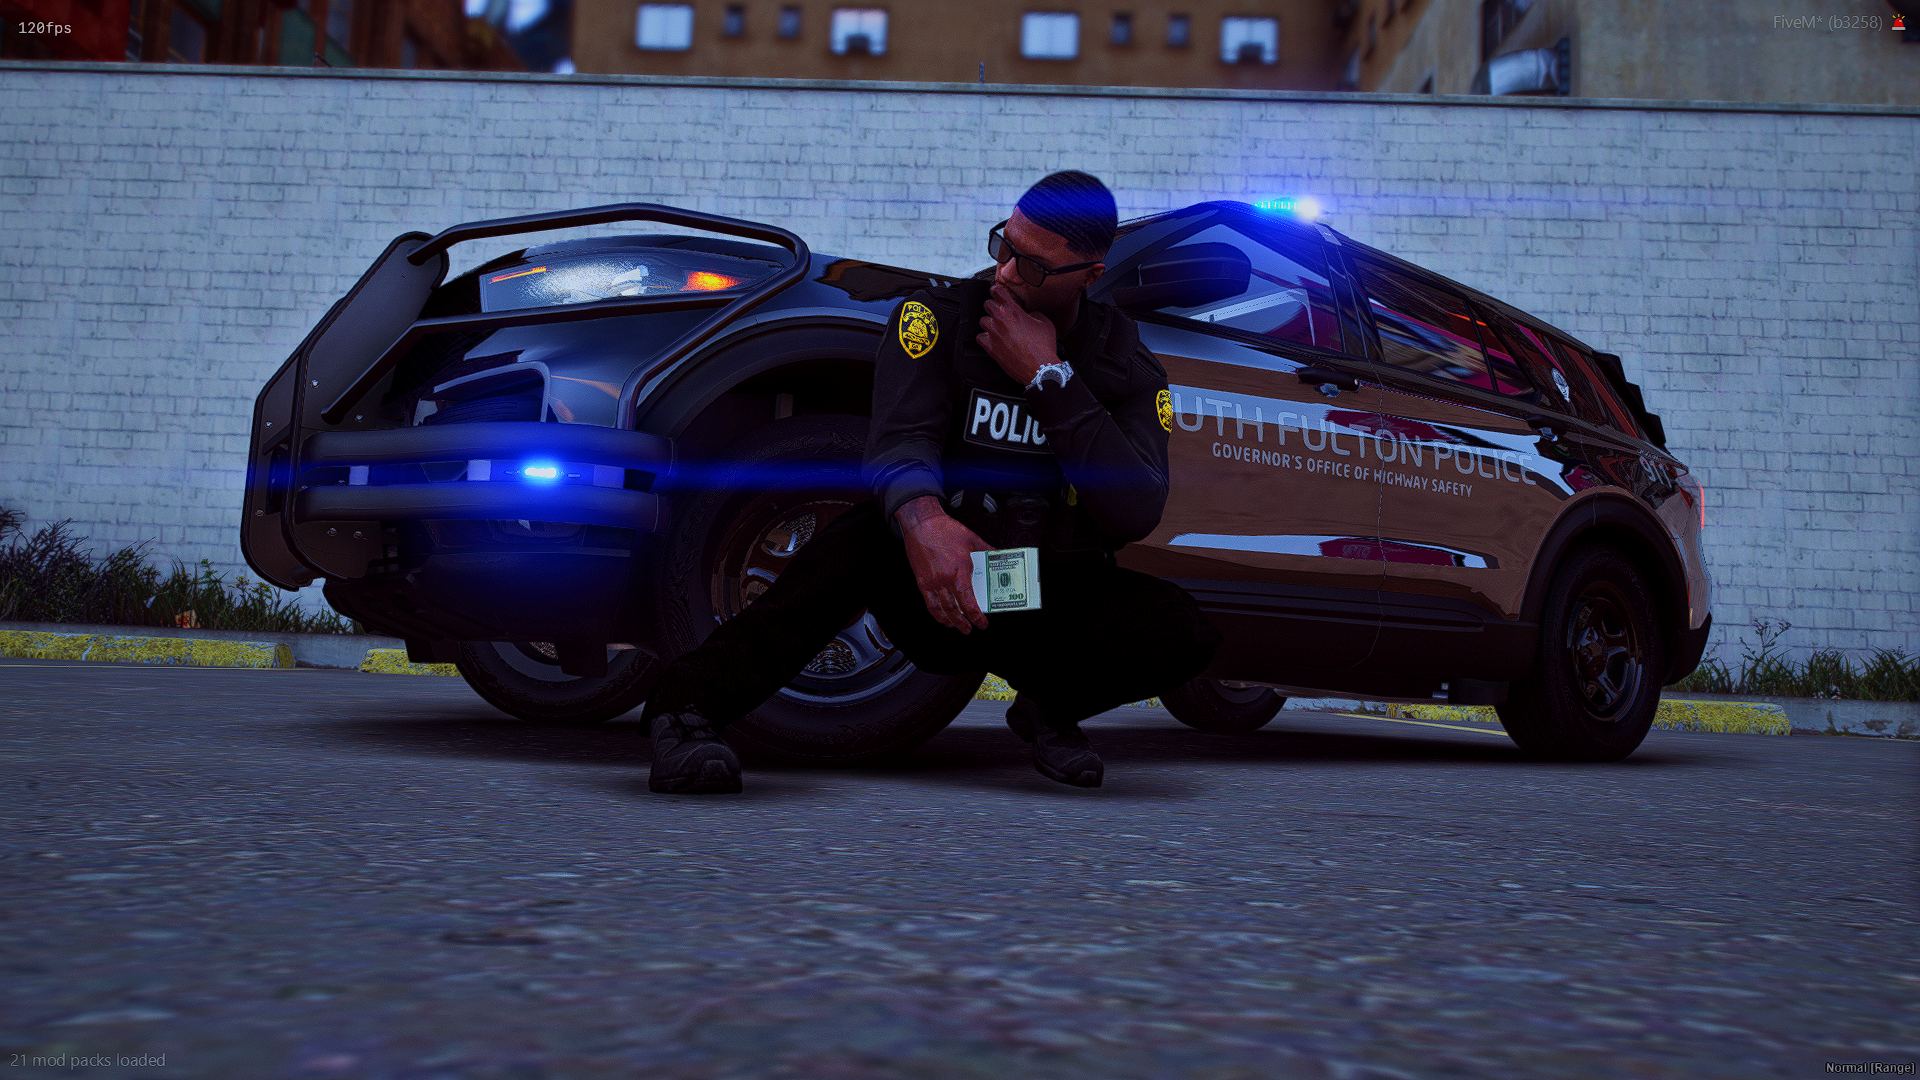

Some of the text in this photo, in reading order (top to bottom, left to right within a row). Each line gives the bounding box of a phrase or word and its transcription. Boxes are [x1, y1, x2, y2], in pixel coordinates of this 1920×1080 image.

[971, 397, 1048, 446] POLIC
[1174, 392, 1537, 486] UTH FULTON POLICE
[1212, 442, 1473, 498] GOVERNOR'S OFFICE OF HIGHWAY SAFETY
[1640, 456, 1673, 488] 911
